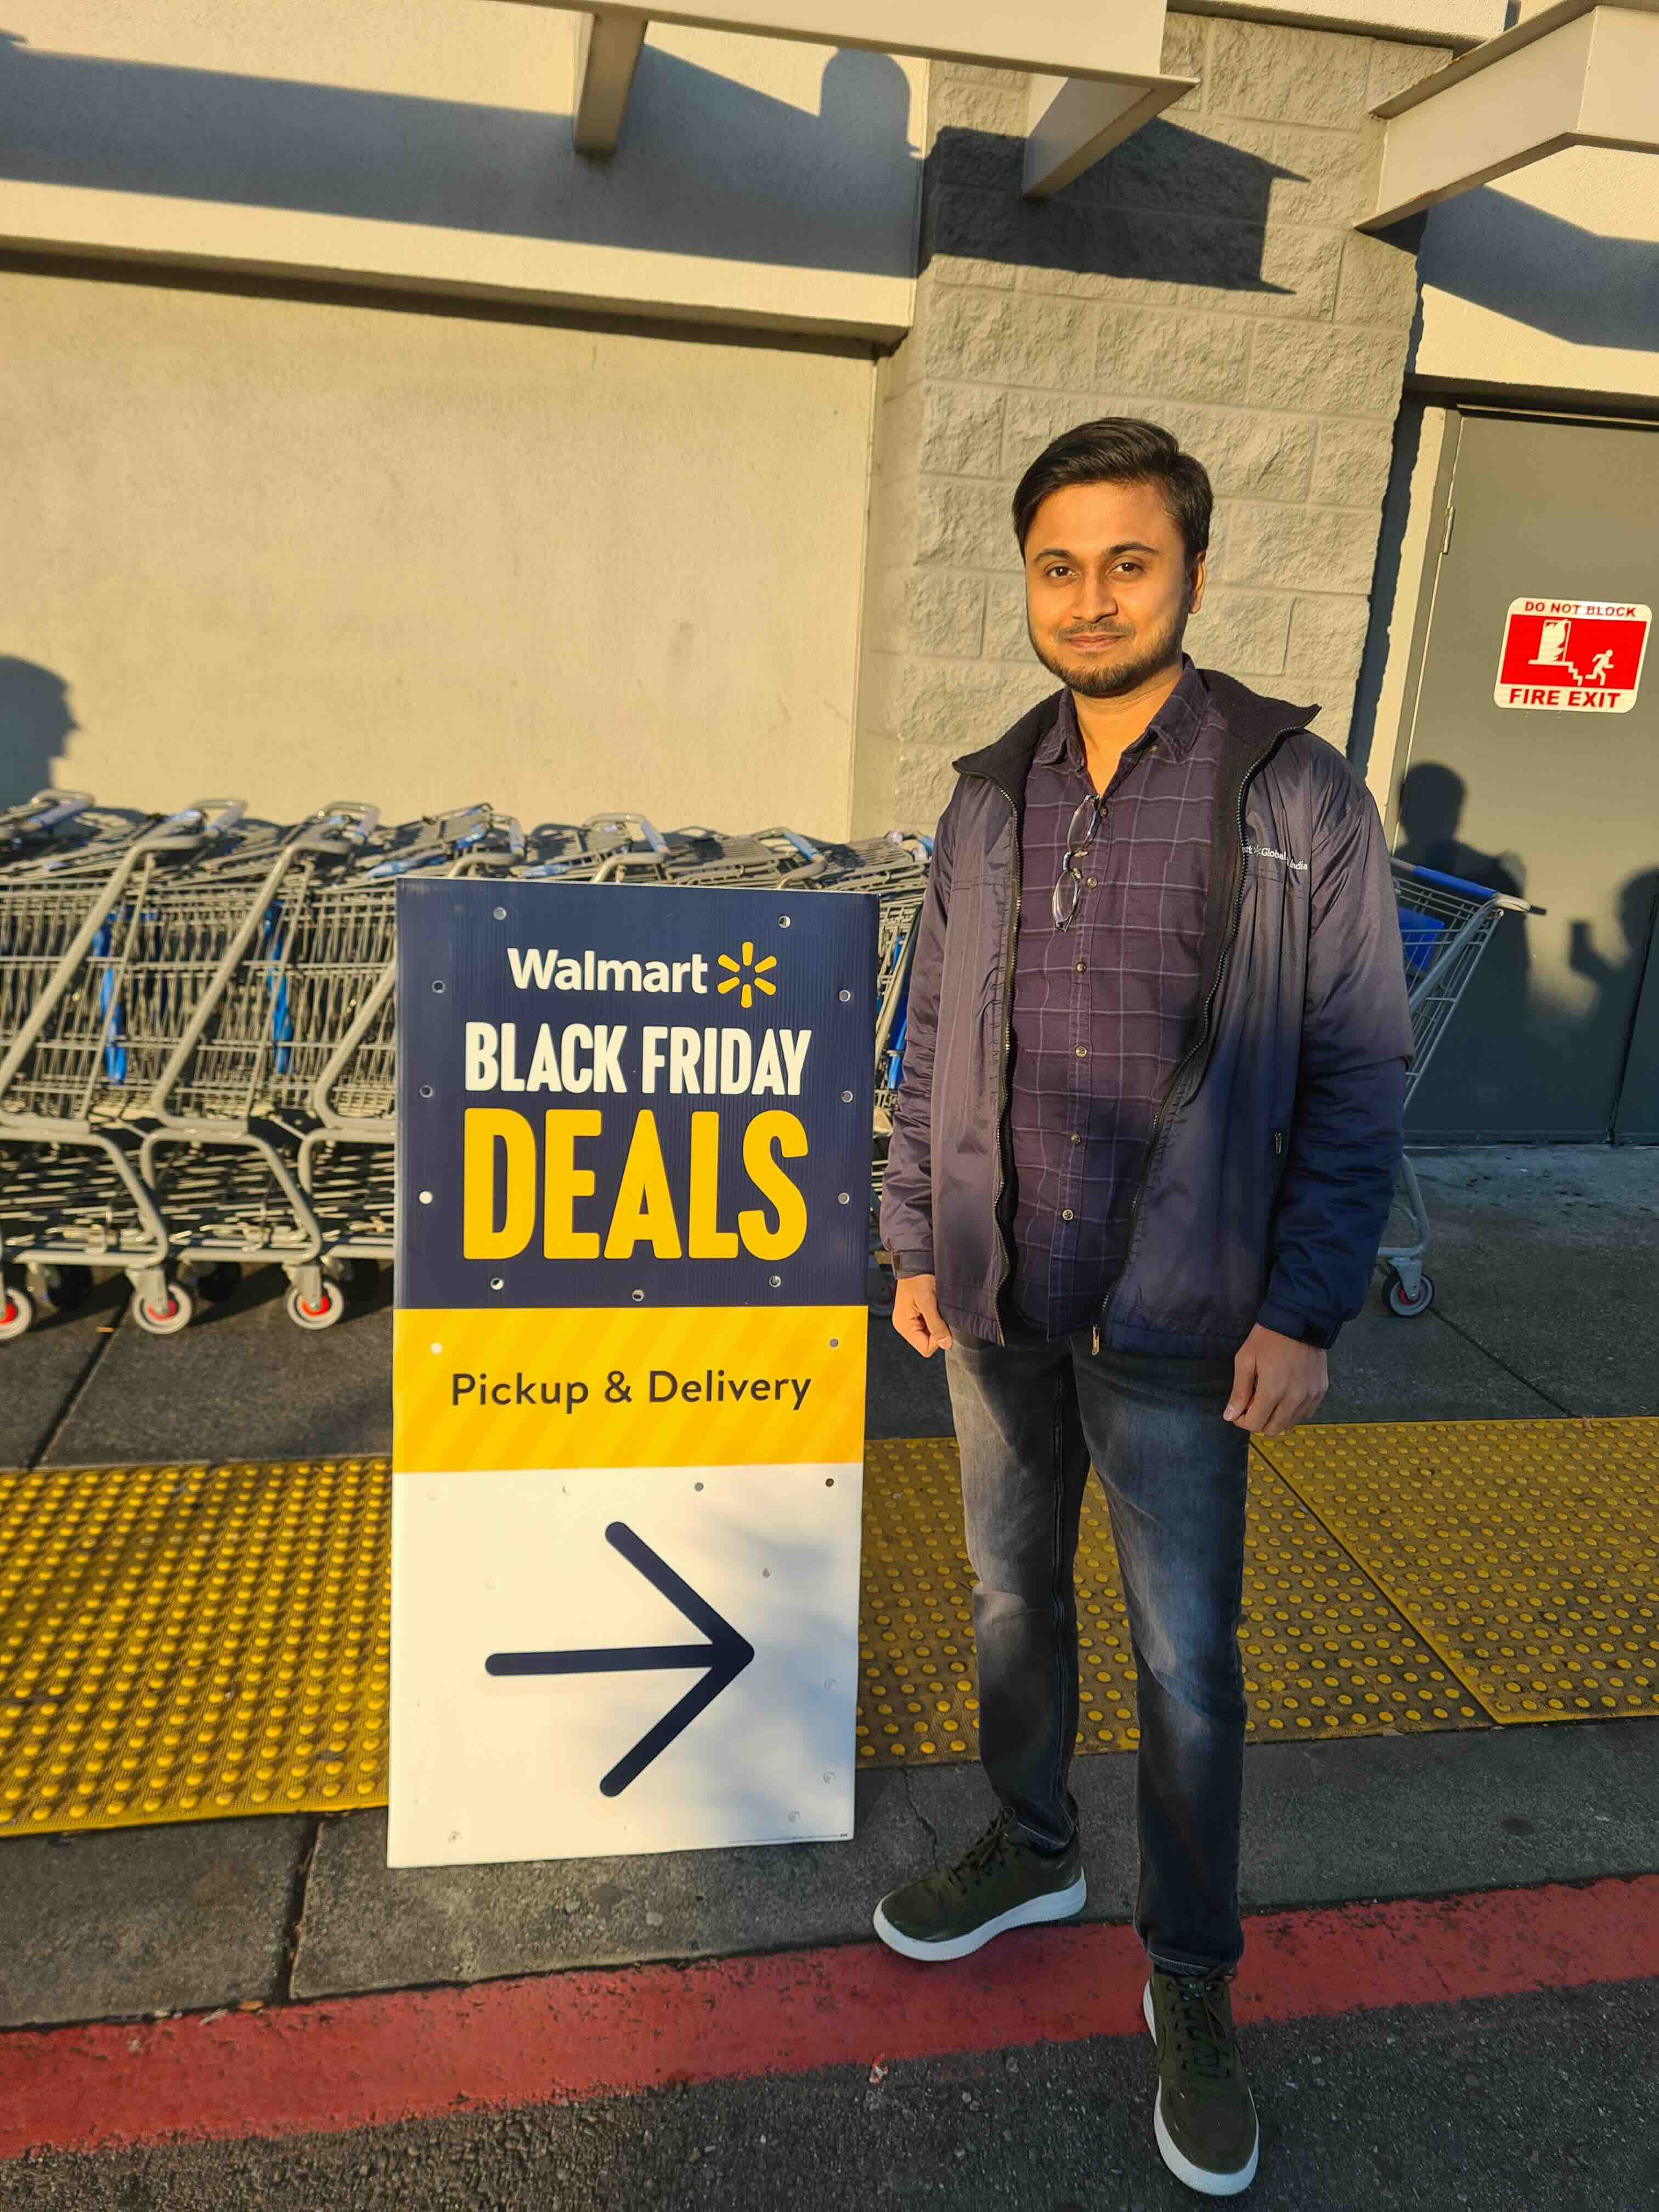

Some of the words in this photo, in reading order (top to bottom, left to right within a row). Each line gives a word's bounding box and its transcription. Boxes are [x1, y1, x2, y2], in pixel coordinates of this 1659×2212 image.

[1525, 601, 1545, 612] DO
[1550, 603, 1581, 614] NOT
[1586, 605, 1637, 617] BLOCK
[1509, 689, 1561, 706] FIRE
[1567, 691, 1621, 708] EXIT
[1261, 847, 1286, 861] Global
[507, 947, 708, 994] Walmart
[465, 1022, 628, 1093] BLACK
[642, 1026, 812, 1096] FRIDAY
[463, 1108, 809, 1261] DEALS
[452, 1372, 589, 1414] Pickup
[604, 1370, 633, 1403] &
[649, 1369, 812, 1410] Delivery
